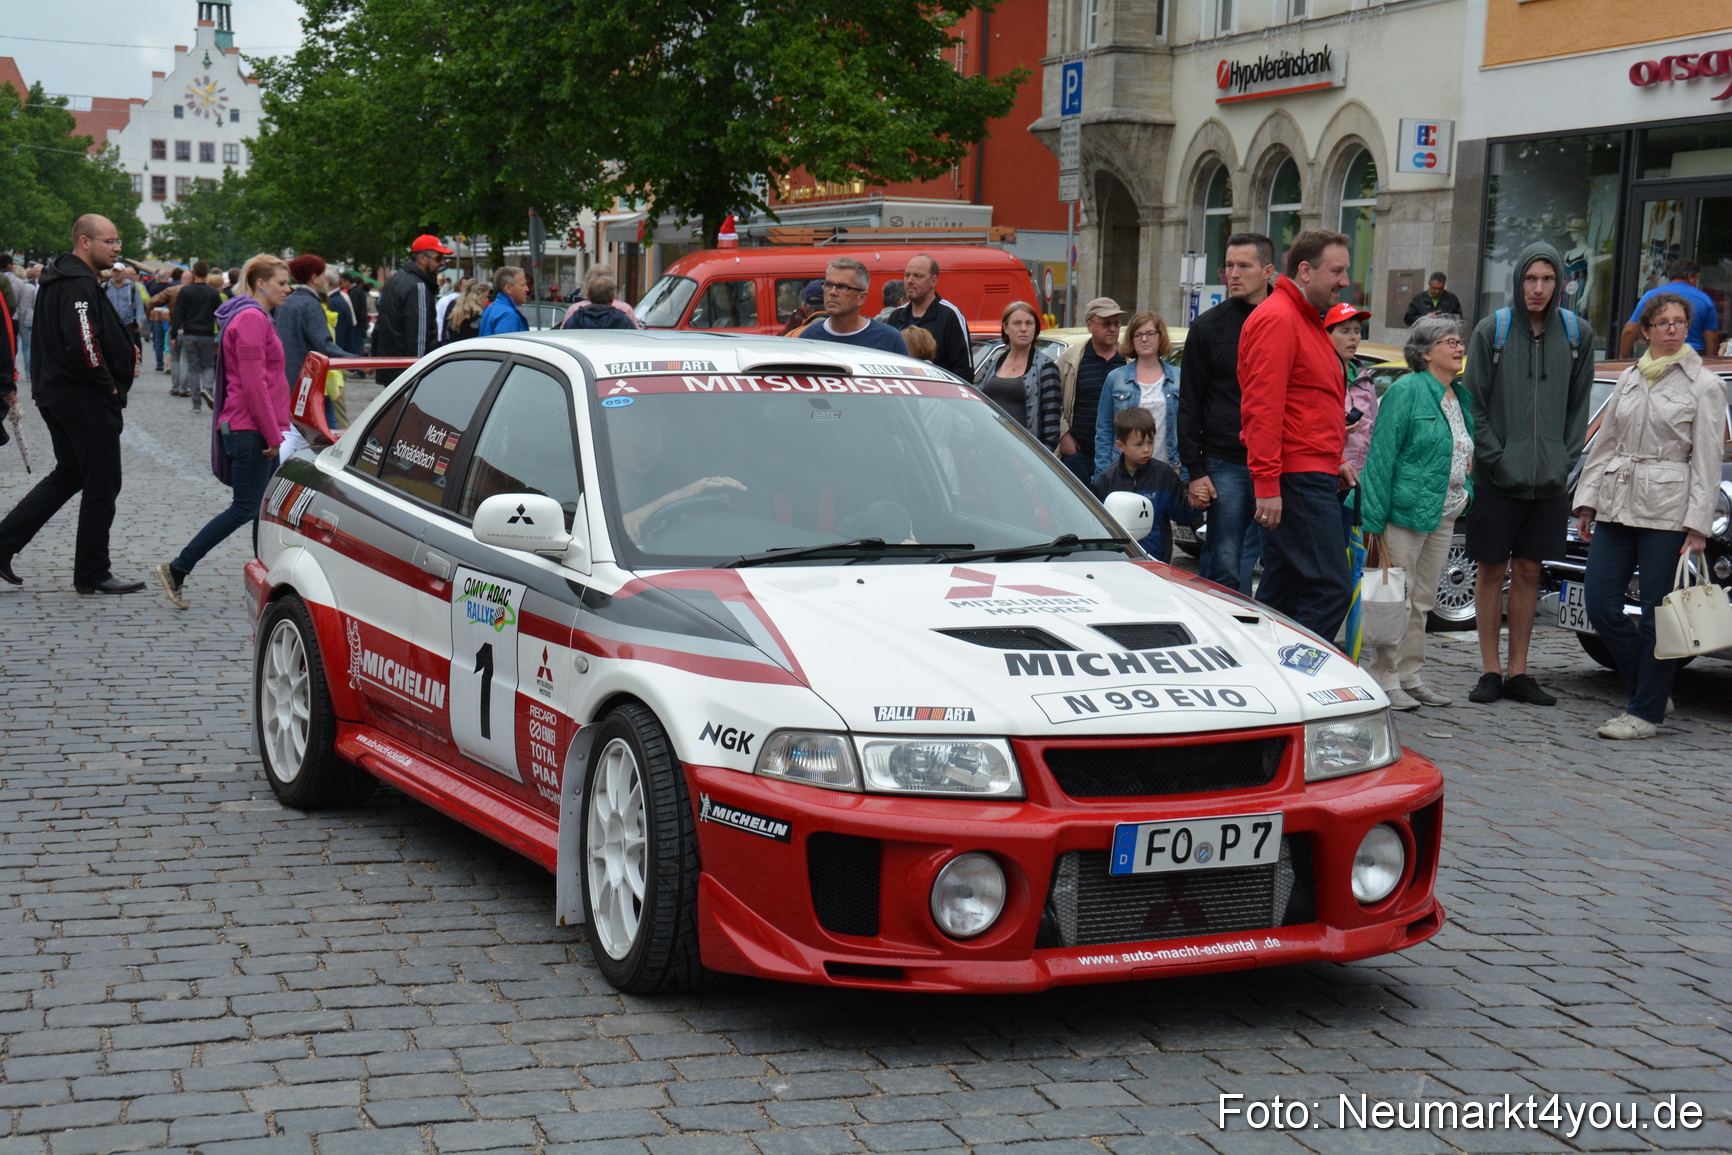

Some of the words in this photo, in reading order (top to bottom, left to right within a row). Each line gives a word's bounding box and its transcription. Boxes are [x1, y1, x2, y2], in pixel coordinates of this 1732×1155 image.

[1229, 44, 1332, 93] HypoVereinsbank
[1065, 69, 1078, 109] P
[611, 361, 653, 373] RALLI
[682, 361, 710, 371] ART
[863, 364, 904, 375] RALLI
[681, 375, 922, 395] MITSUBISHI
[424, 424, 448, 446] Macht
[393, 439, 435, 470] Schnädelbach
[464, 577, 487, 599] OMV
[487, 584, 511, 607] ADAC
[948, 598, 1099, 608] MITSUBISHI
[467, 600, 494, 627] RALLYE
[984, 606, 1093, 615] MOTORS
[1003, 645, 1242, 676] MICHELIN
[363, 649, 446, 709] MICHELIN
[473, 642, 493, 740] 1
[877, 706, 916, 721] RALLI
[944, 707, 971, 721] ART
[1062, 694, 1100, 715] N
[1104, 689, 1159, 711] 99
[1164, 688, 1248, 707] EVO
[530, 705, 557, 726] RECARO
[699, 720, 754, 755] NGK
[530, 741, 557, 768] TOTAL
[532, 761, 559, 789] PIAA
[711, 805, 788, 837] MICHELIN
[1145, 827, 1193, 866] FO
[1219, 823, 1241, 861] P
[1252, 821, 1272, 859] 7
[1119, 854, 1128, 865] D
[1121, 938, 1257, 962] auto-macht-eckental
